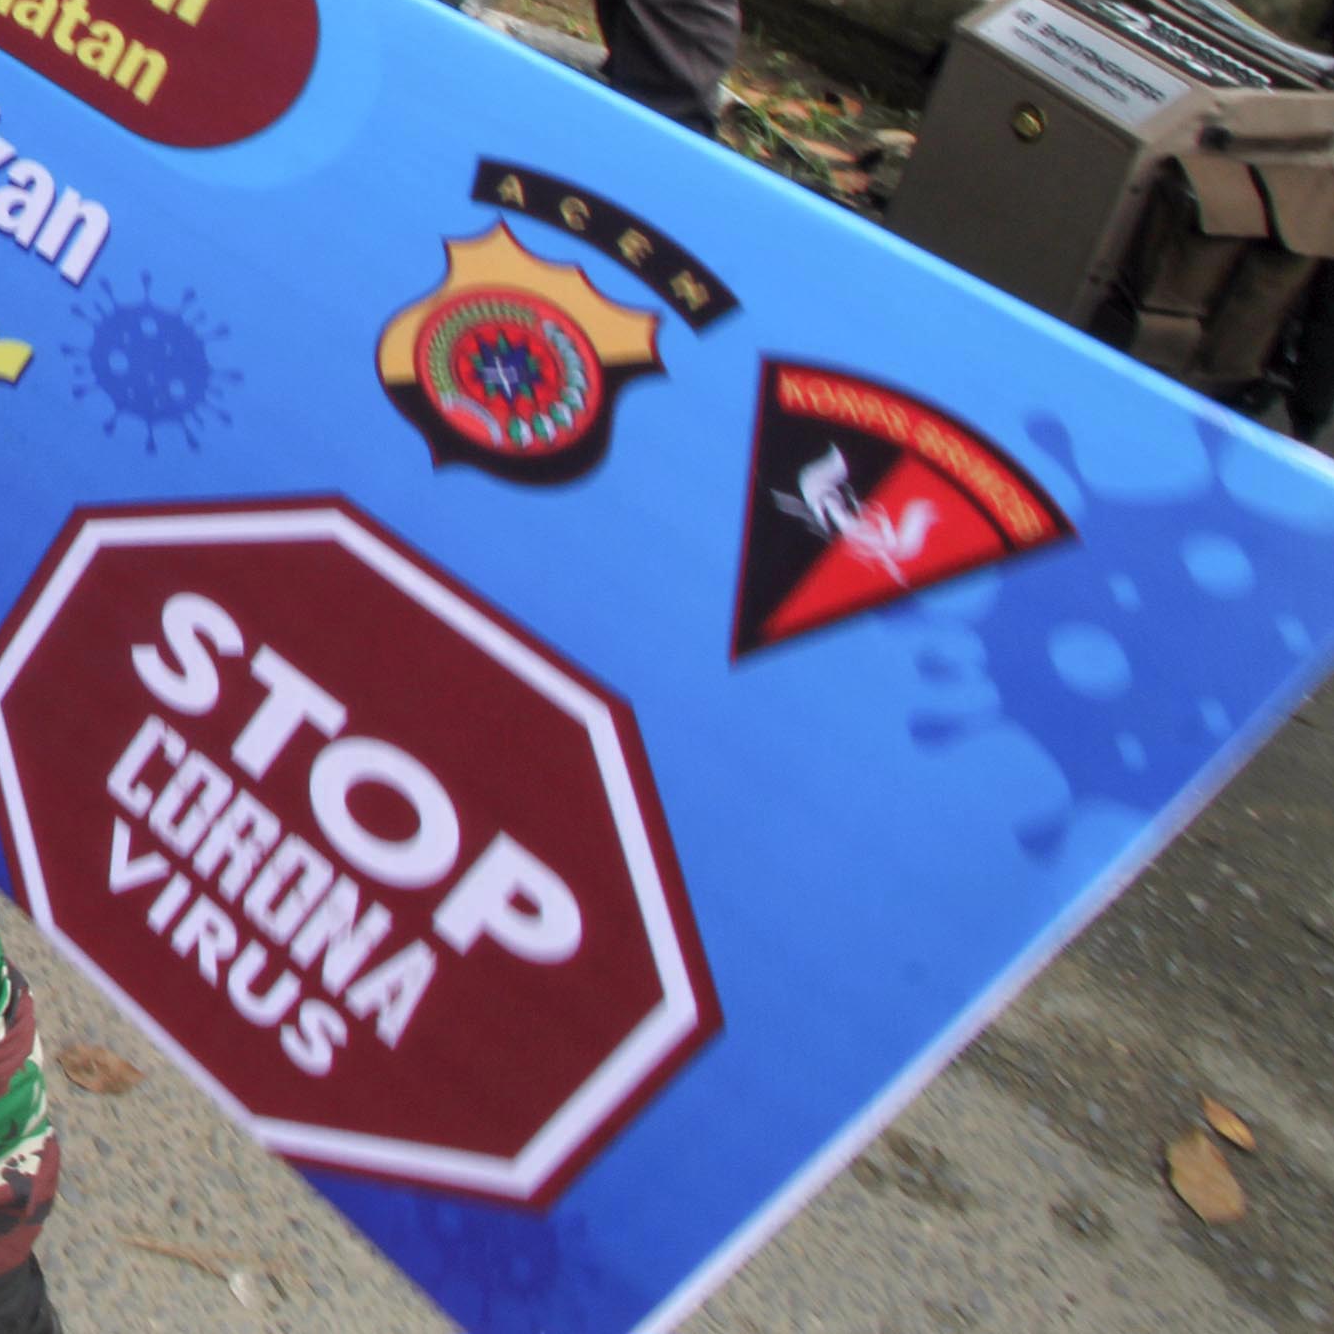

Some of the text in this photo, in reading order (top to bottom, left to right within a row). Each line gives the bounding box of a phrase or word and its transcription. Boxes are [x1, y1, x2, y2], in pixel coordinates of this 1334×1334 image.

[105, 715, 438, 1051] CORONA
[130, 592, 582, 964] STOP
[108, 818, 349, 1077] VIRUS
